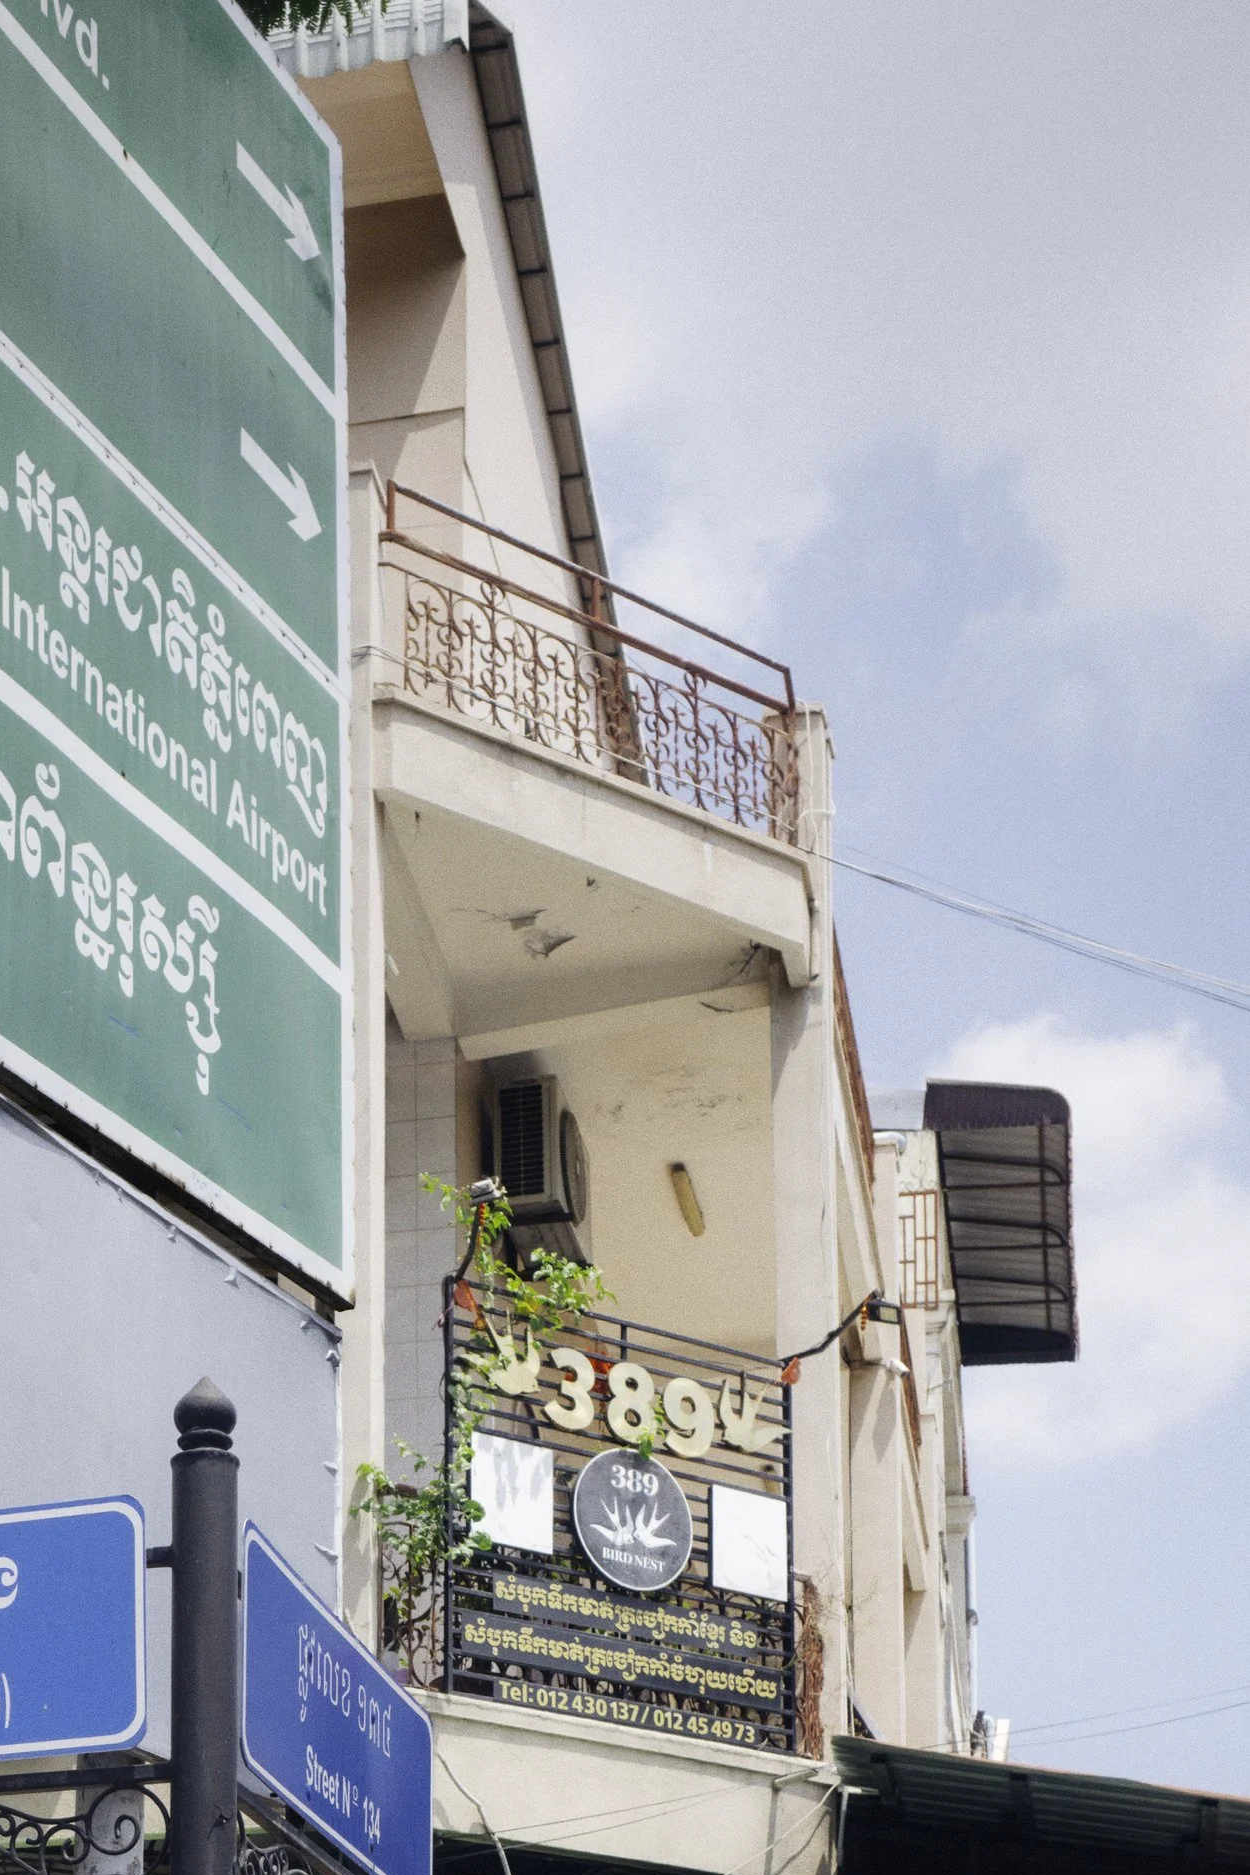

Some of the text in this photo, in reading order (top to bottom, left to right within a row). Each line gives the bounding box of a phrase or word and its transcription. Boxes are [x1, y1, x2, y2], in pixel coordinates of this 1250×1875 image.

[40, 0, 110, 91] vd.
[1, 566, 218, 816] International
[226, 786, 328, 917] Airport
[542, 1347, 716, 1459] 389
[610, 1464, 660, 1497] 389
[602, 1547, 666, 1573] BIRD NEST
[536, 1687, 569, 1711] 012
[572, 1693, 607, 1717] 430
[609, 1700, 639, 1724] 137
[653, 1709, 684, 1732] 012
[305, 1744, 340, 1810] Street
[362, 1796, 381, 1844] 134
